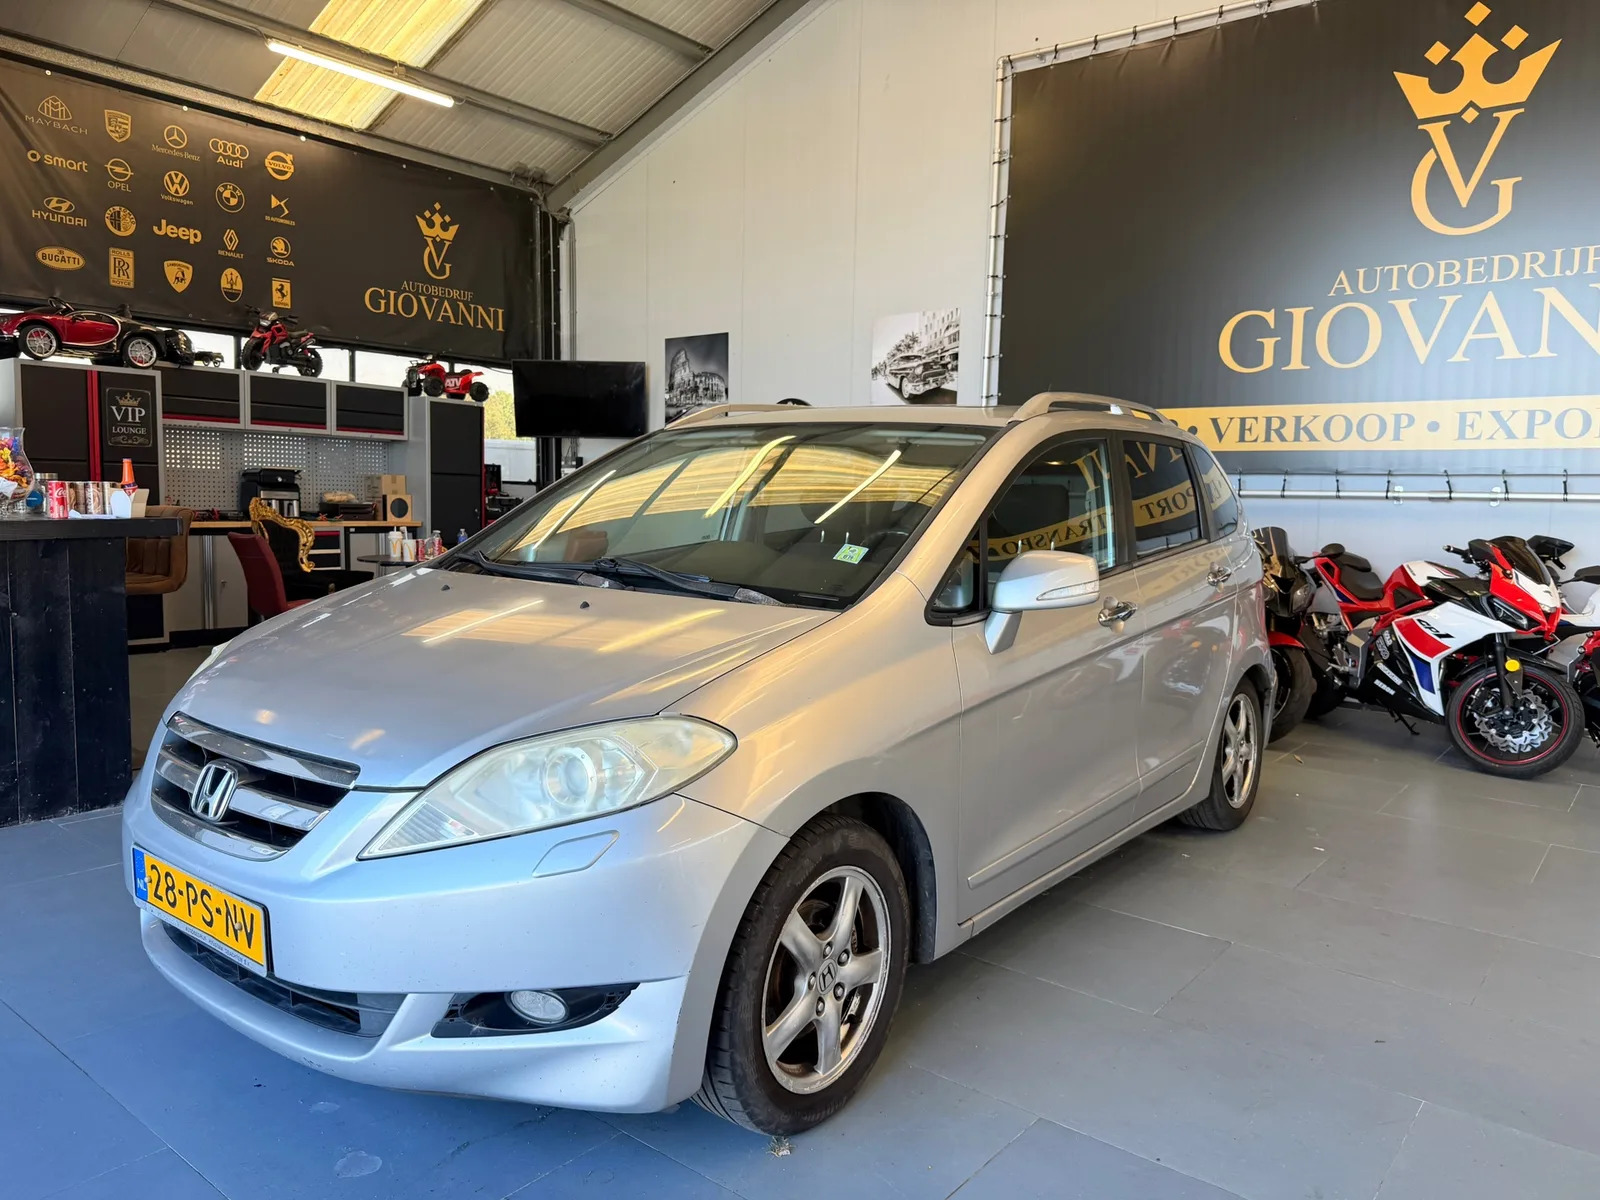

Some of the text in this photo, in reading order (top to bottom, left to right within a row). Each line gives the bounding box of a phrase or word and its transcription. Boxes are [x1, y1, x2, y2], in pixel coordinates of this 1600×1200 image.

[25, 115, 88, 135] MAYBACH
[152, 144, 200, 161] Mercedes-Benz
[43, 153, 88, 173] smart
[217, 156, 243, 168] Audi
[268, 160, 292, 171] VOLVO
[107, 181, 132, 192] OPEL
[160, 193, 194, 206] Volkswagen
[32, 210, 87, 227] HYUNDAI
[152, 219, 203, 244] Jeep
[41, 252, 81, 266] BUGATTI
[217, 249, 245, 259] RENAULT
[401, 281, 474, 302] AUTOBEDRIJF
[364, 287, 505, 332] GIOVANNI
[445, 377, 461, 388] ATV
[110, 405, 146, 422] VIP
[112, 426, 147, 435] LOUNGE
[1209, 407, 1600, 444] VERKOOP EXPO
[137, 877, 147, 891] NL
[150, 864, 255, 950] 28-PS-NV
